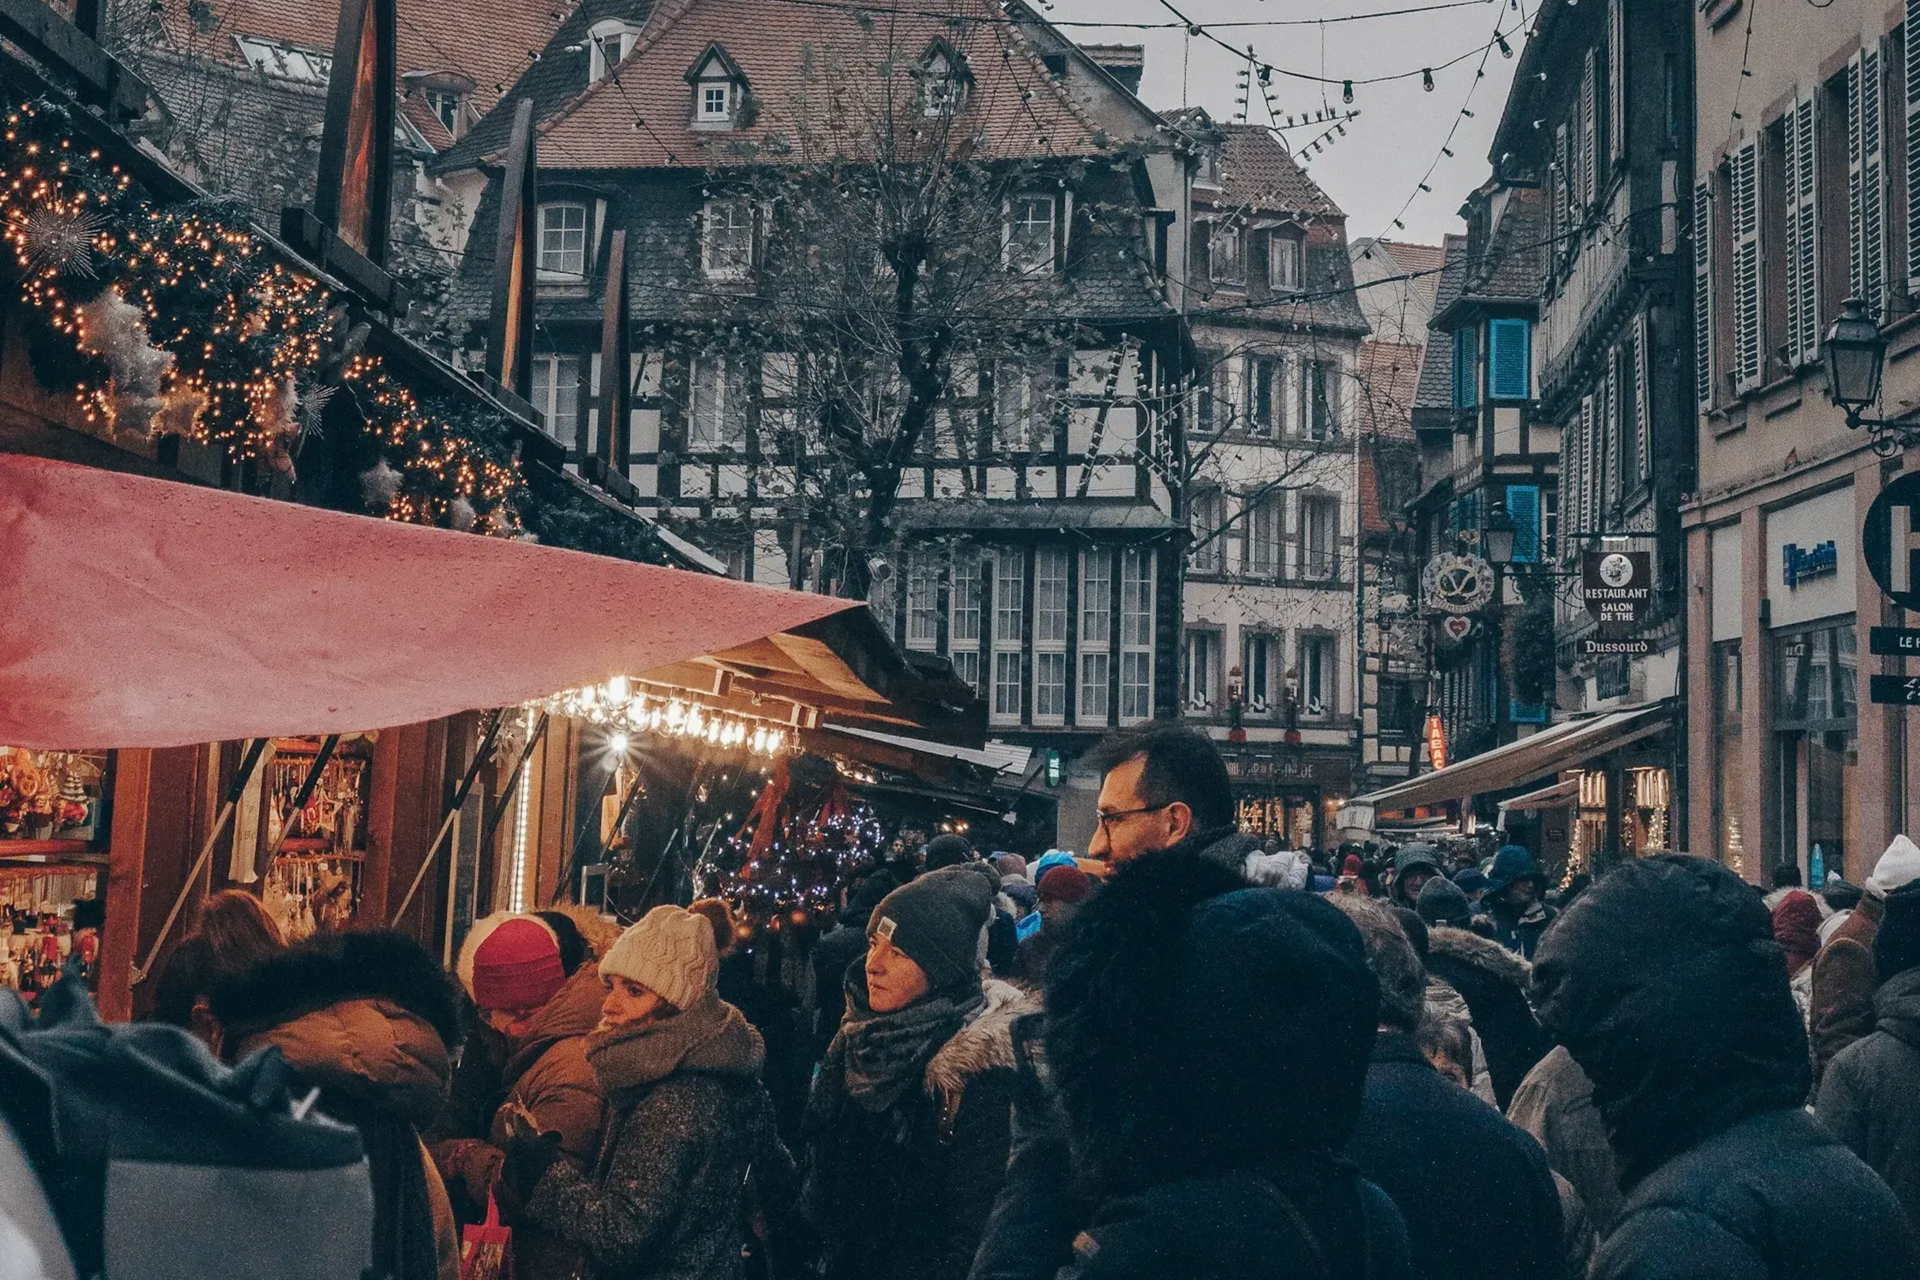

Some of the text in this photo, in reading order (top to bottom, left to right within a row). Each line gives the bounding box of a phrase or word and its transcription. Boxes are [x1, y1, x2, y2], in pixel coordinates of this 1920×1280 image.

[1585, 588, 1648, 599] RESTAURANT
[1601, 602, 1633, 612] SALON
[1600, 612, 1635, 621] DE THE
[1585, 640, 1648, 653] Dussourd
[1899, 636, 1913, 648] LE
[1430, 718, 1443, 770] TABAC
